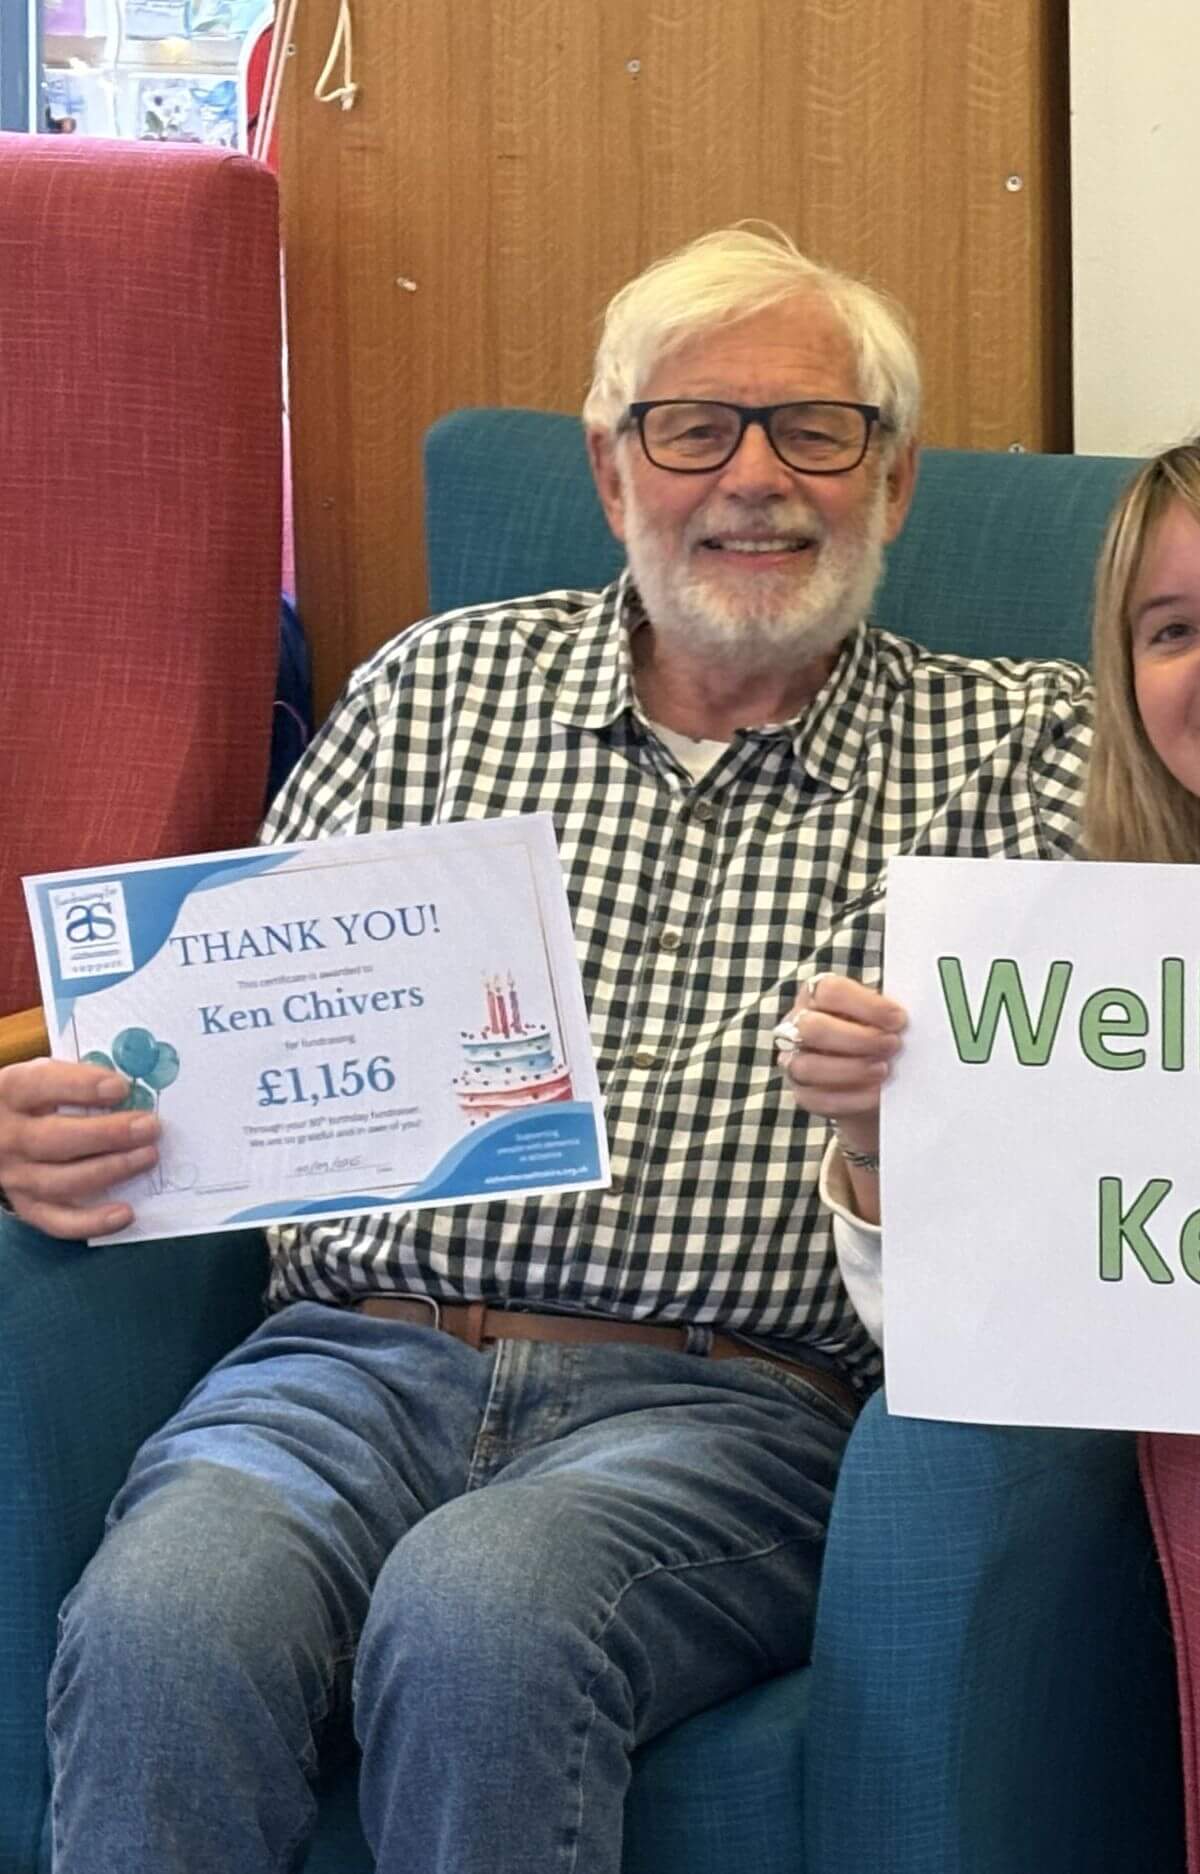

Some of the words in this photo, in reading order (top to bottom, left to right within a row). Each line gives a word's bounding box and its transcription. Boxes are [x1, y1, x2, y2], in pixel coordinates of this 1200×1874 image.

[169, 919, 326, 967] THANK
[333, 904, 440, 945] YOU!
[237, 980, 259, 989] This
[260, 974, 306, 988] certificate
[319, 966, 361, 979] awarded
[200, 1005, 275, 1035] Ken
[283, 986, 424, 1023] Chivers
[285, 1039, 299, 1050] for
[301, 1034, 356, 1048] fundraising
[256, 1055, 396, 1106] £1,156
